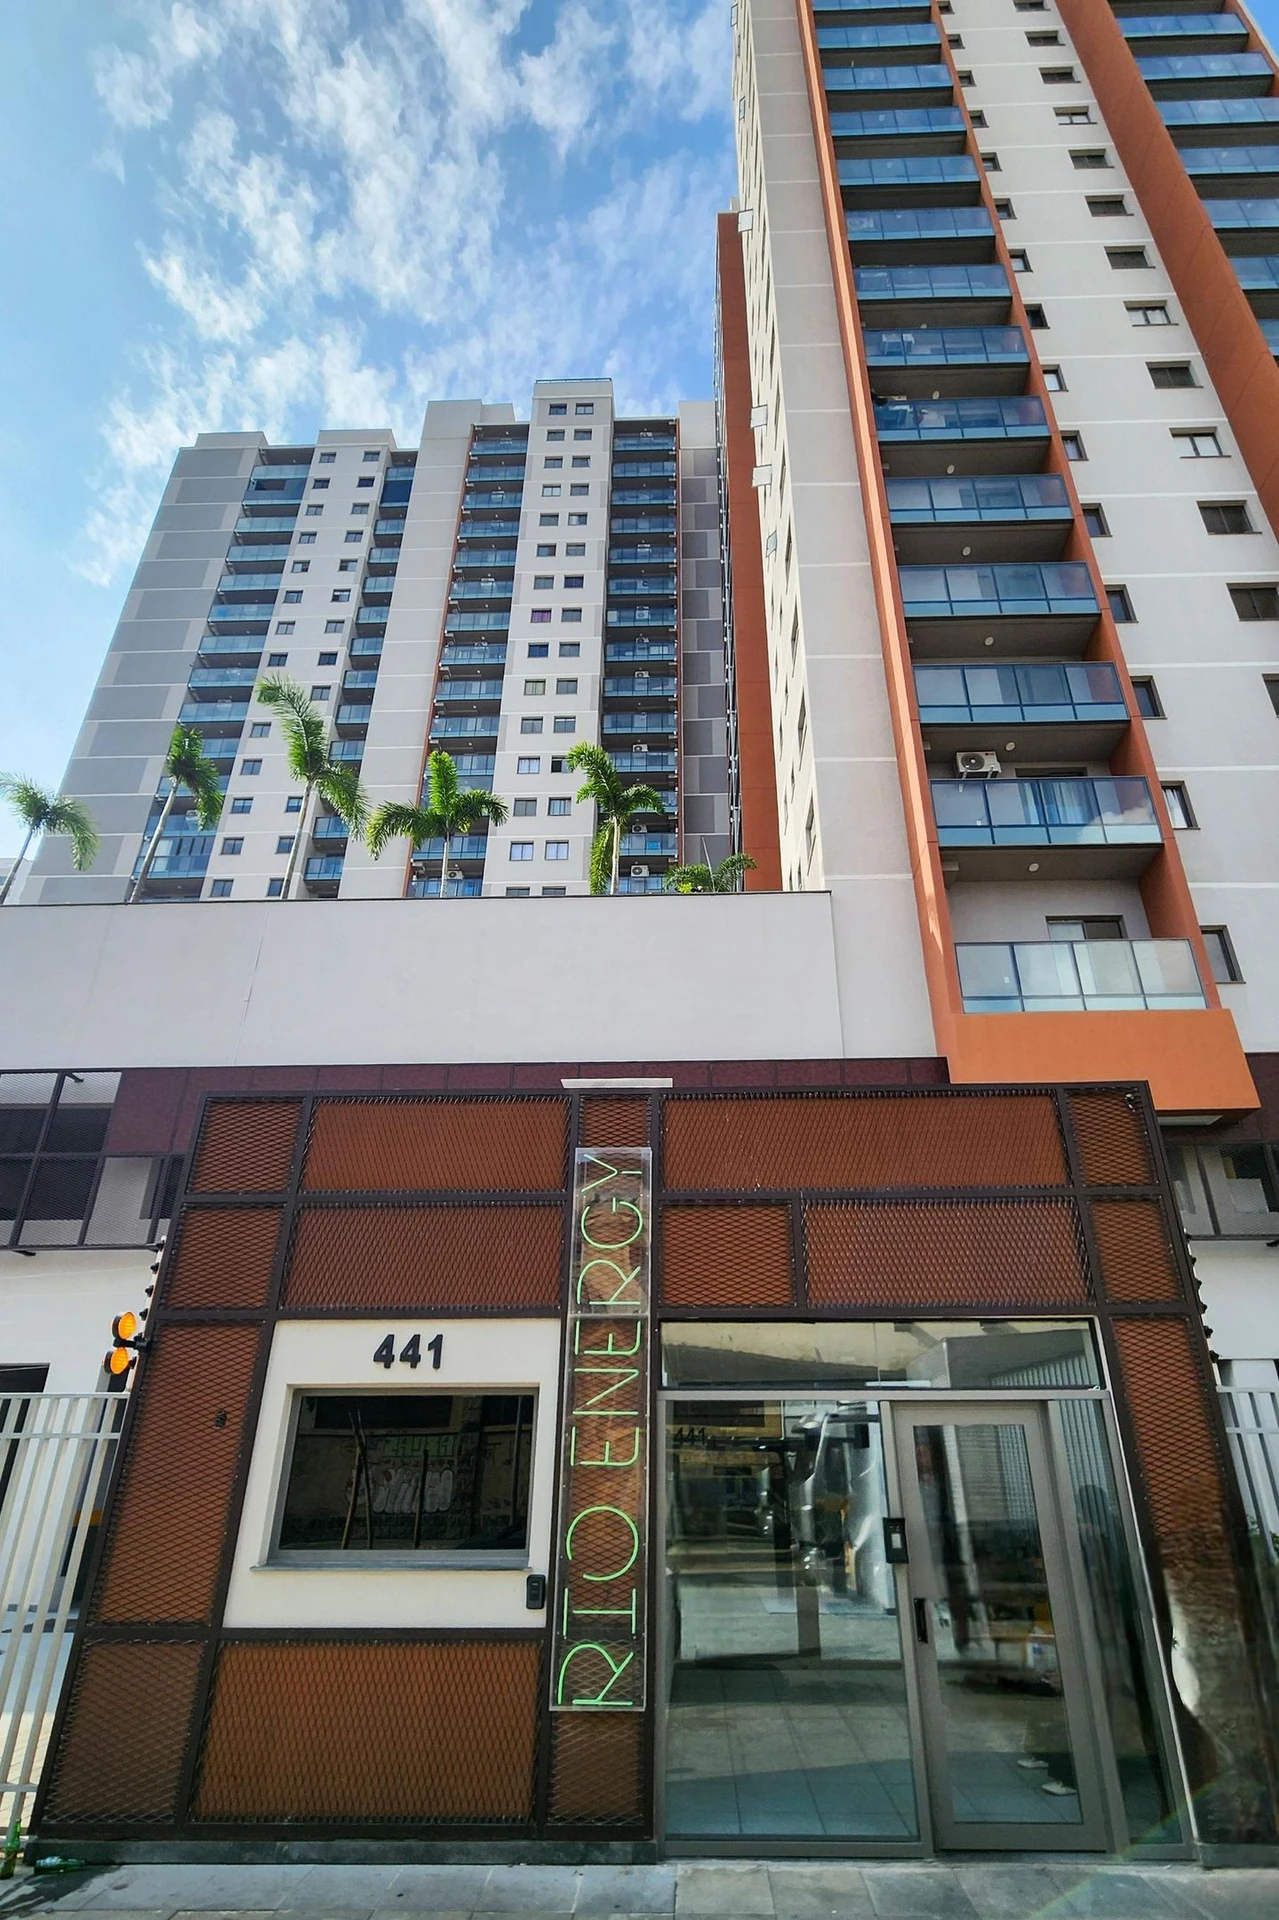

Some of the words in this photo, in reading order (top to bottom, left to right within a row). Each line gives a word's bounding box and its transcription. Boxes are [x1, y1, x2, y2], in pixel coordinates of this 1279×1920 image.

[373, 1333, 444, 1369] 441
[570, 1154, 643, 1467] ENERGY
[673, 1427, 706, 1446] 441
[557, 1505, 639, 1706] RIO
